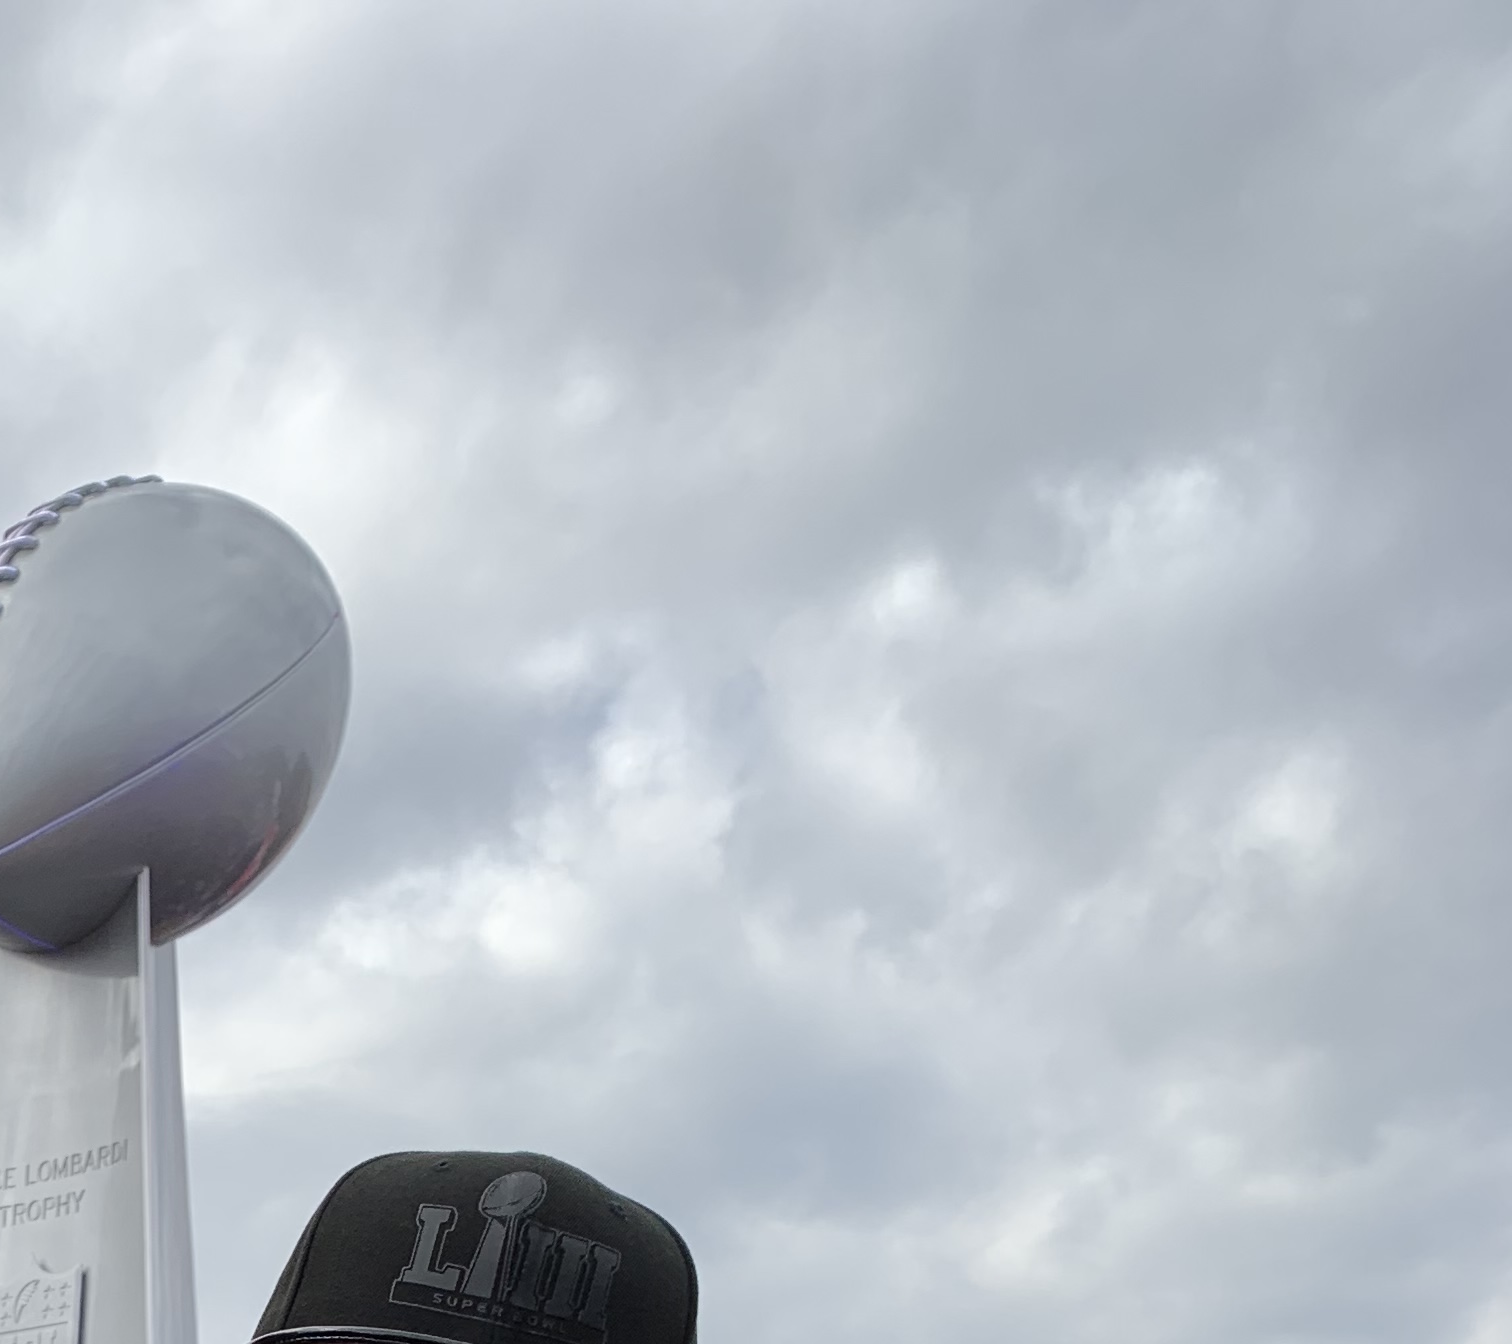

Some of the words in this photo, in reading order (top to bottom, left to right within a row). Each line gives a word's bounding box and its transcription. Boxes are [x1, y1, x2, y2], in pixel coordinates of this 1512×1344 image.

[24, 1138, 129, 1187] LOMBARDI
[0, 1189, 86, 1228] TROPHY
[432, 1292, 504, 1318] SUPER
[513, 1310, 567, 1333] BOWL
